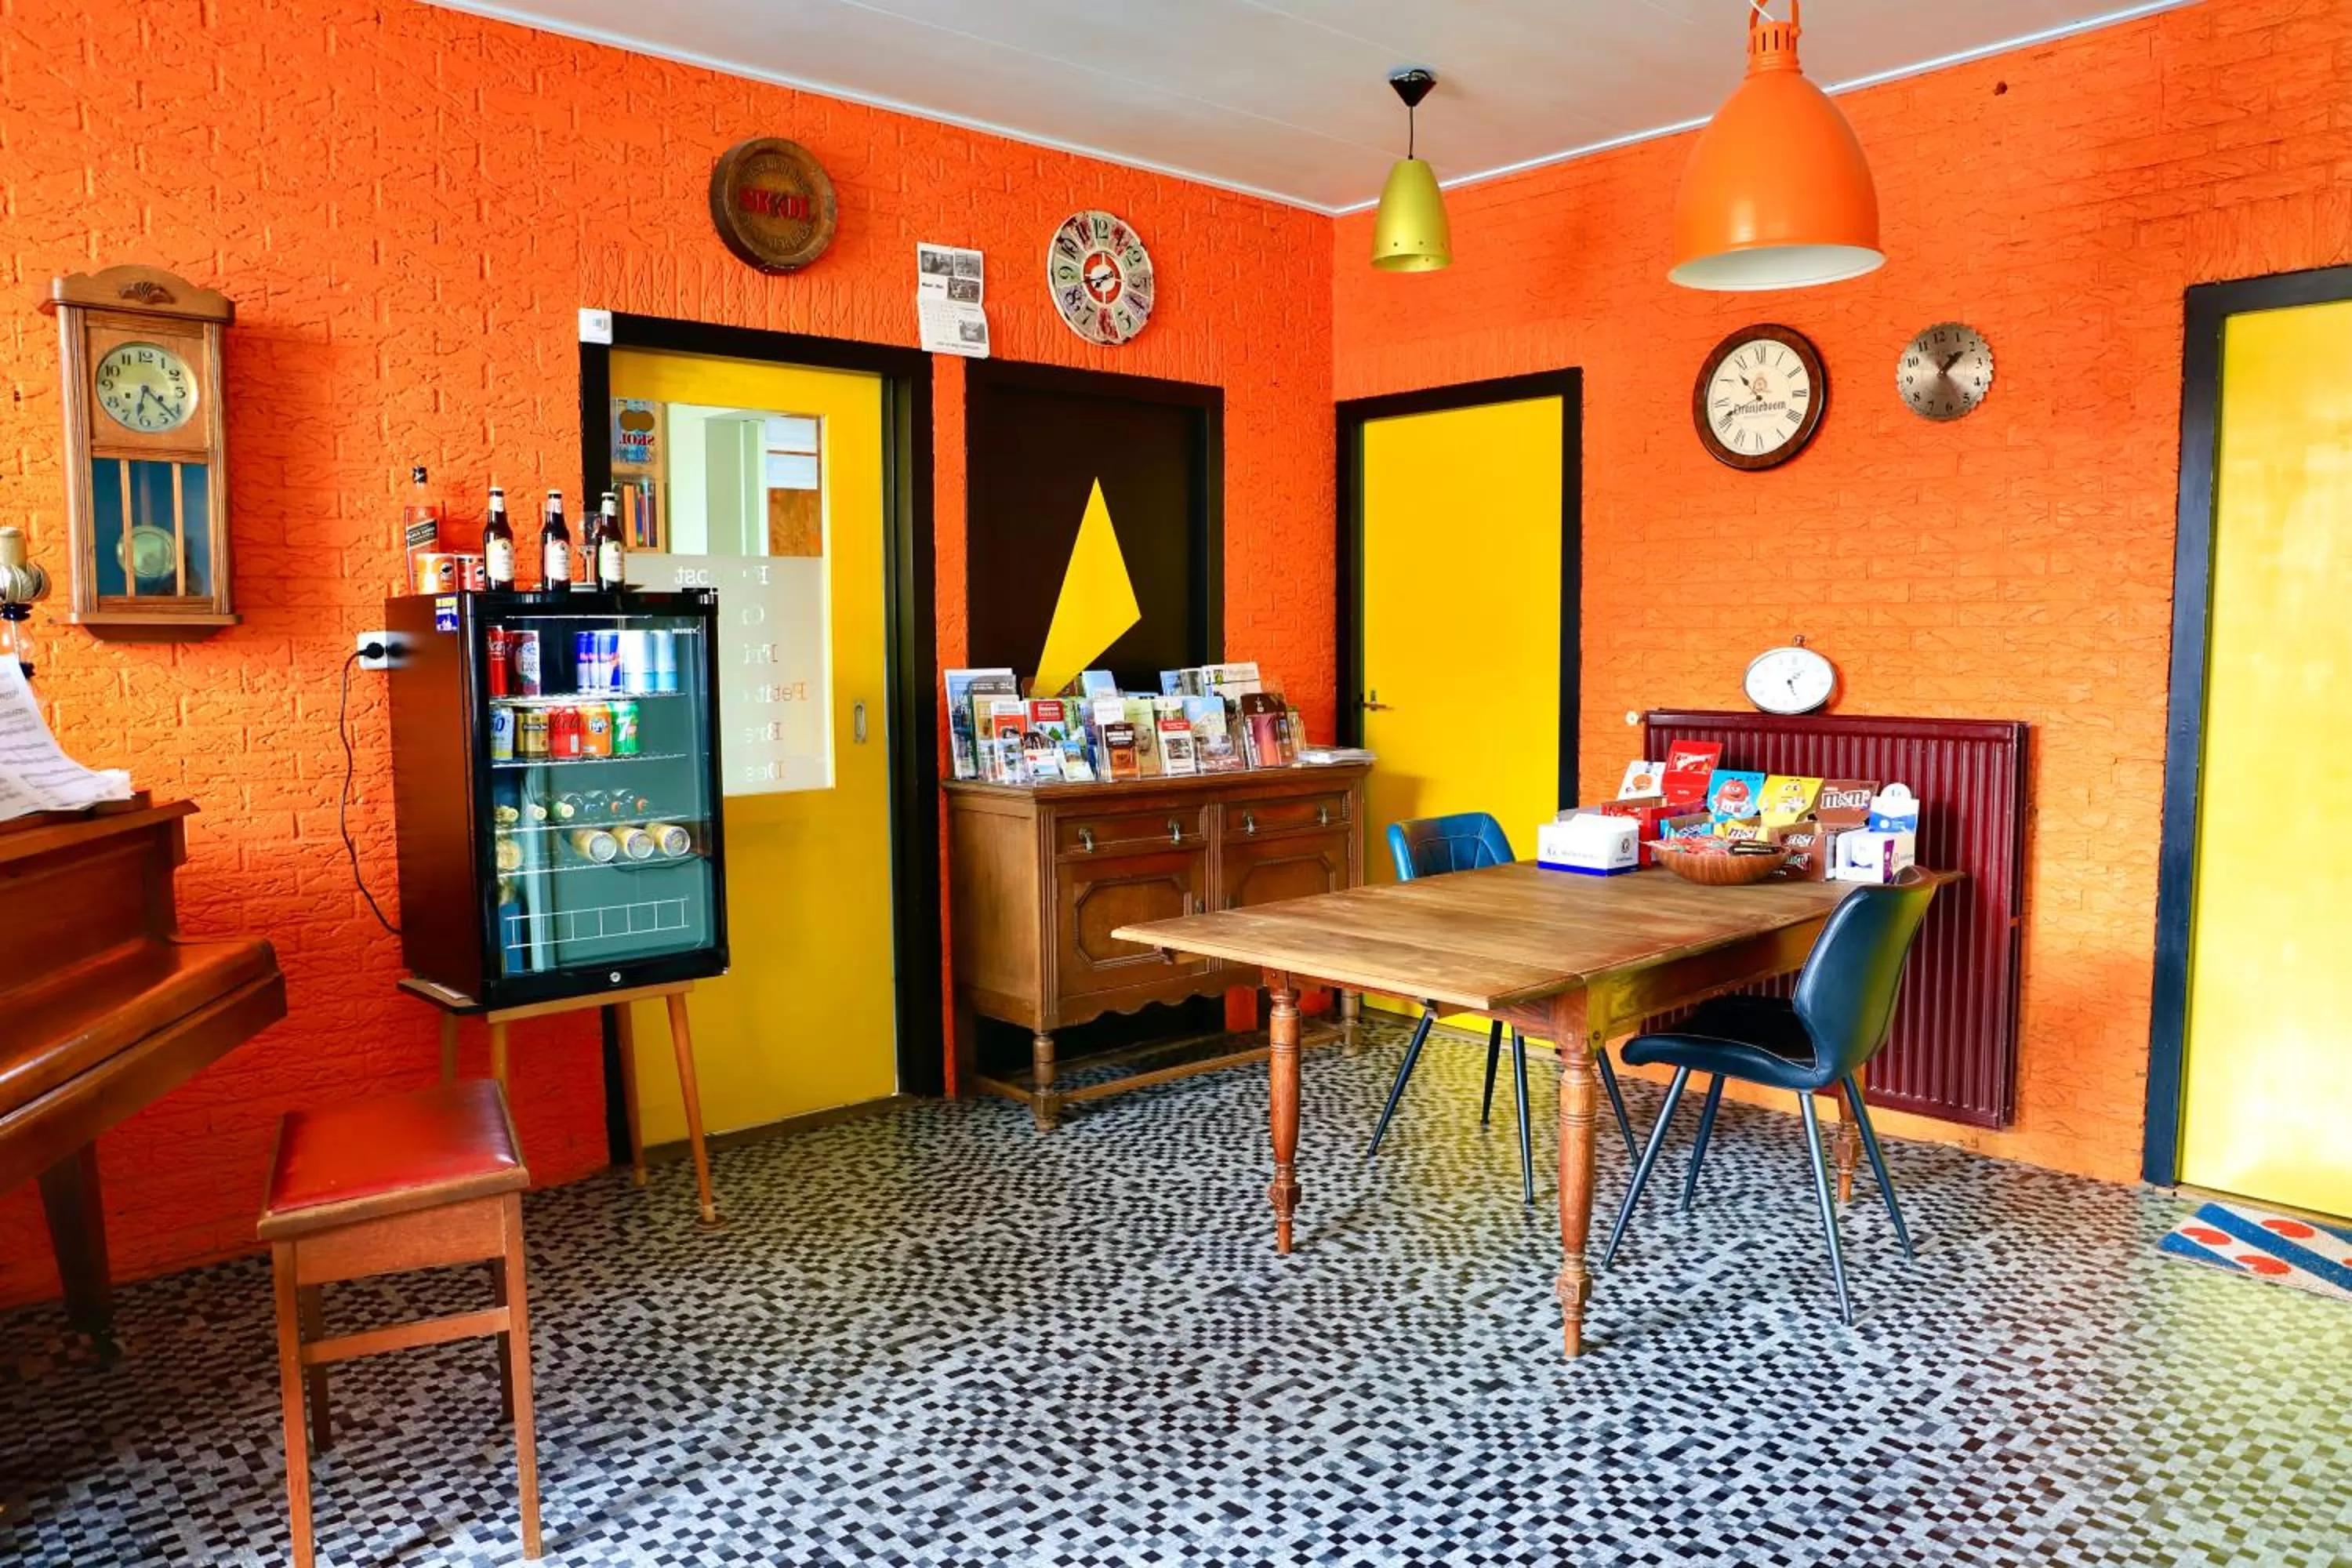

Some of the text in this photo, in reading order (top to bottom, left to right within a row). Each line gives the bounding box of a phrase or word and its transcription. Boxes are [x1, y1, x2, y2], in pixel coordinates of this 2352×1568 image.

[1091, 217, 1109, 239] 12
[1059, 266, 1076, 280] 9
[1065, 289, 1082, 311] 8
[1933, 331, 1945, 344] 12
[1955, 332, 1960, 343] 1
[1918, 340, 1928, 352] 11
[1969, 341, 1976, 352] 2
[122, 354, 131, 366] 11
[138, 351, 154, 363] 12
[161, 357, 165, 369] 1
[1907, 357, 1919, 368] 10
[106, 365, 121, 377] 10
[169, 369, 180, 382] 2
[101, 379, 114, 391] 9
[1906, 376, 1914, 385] 9
[1974, 376, 1980, 387] 4
[175, 387, 186, 399] 3
[1913, 392, 1920, 403] 8
[1963, 393, 1970, 404] 5
[107, 396, 119, 408] 8
[1927, 401, 1934, 412] 7
[1945, 401, 1953, 412] 6
[122, 409, 129, 421] 7
[139, 416, 151, 426] 6
[159, 412, 169, 424] 5
[616, 716, 632, 741] 7
